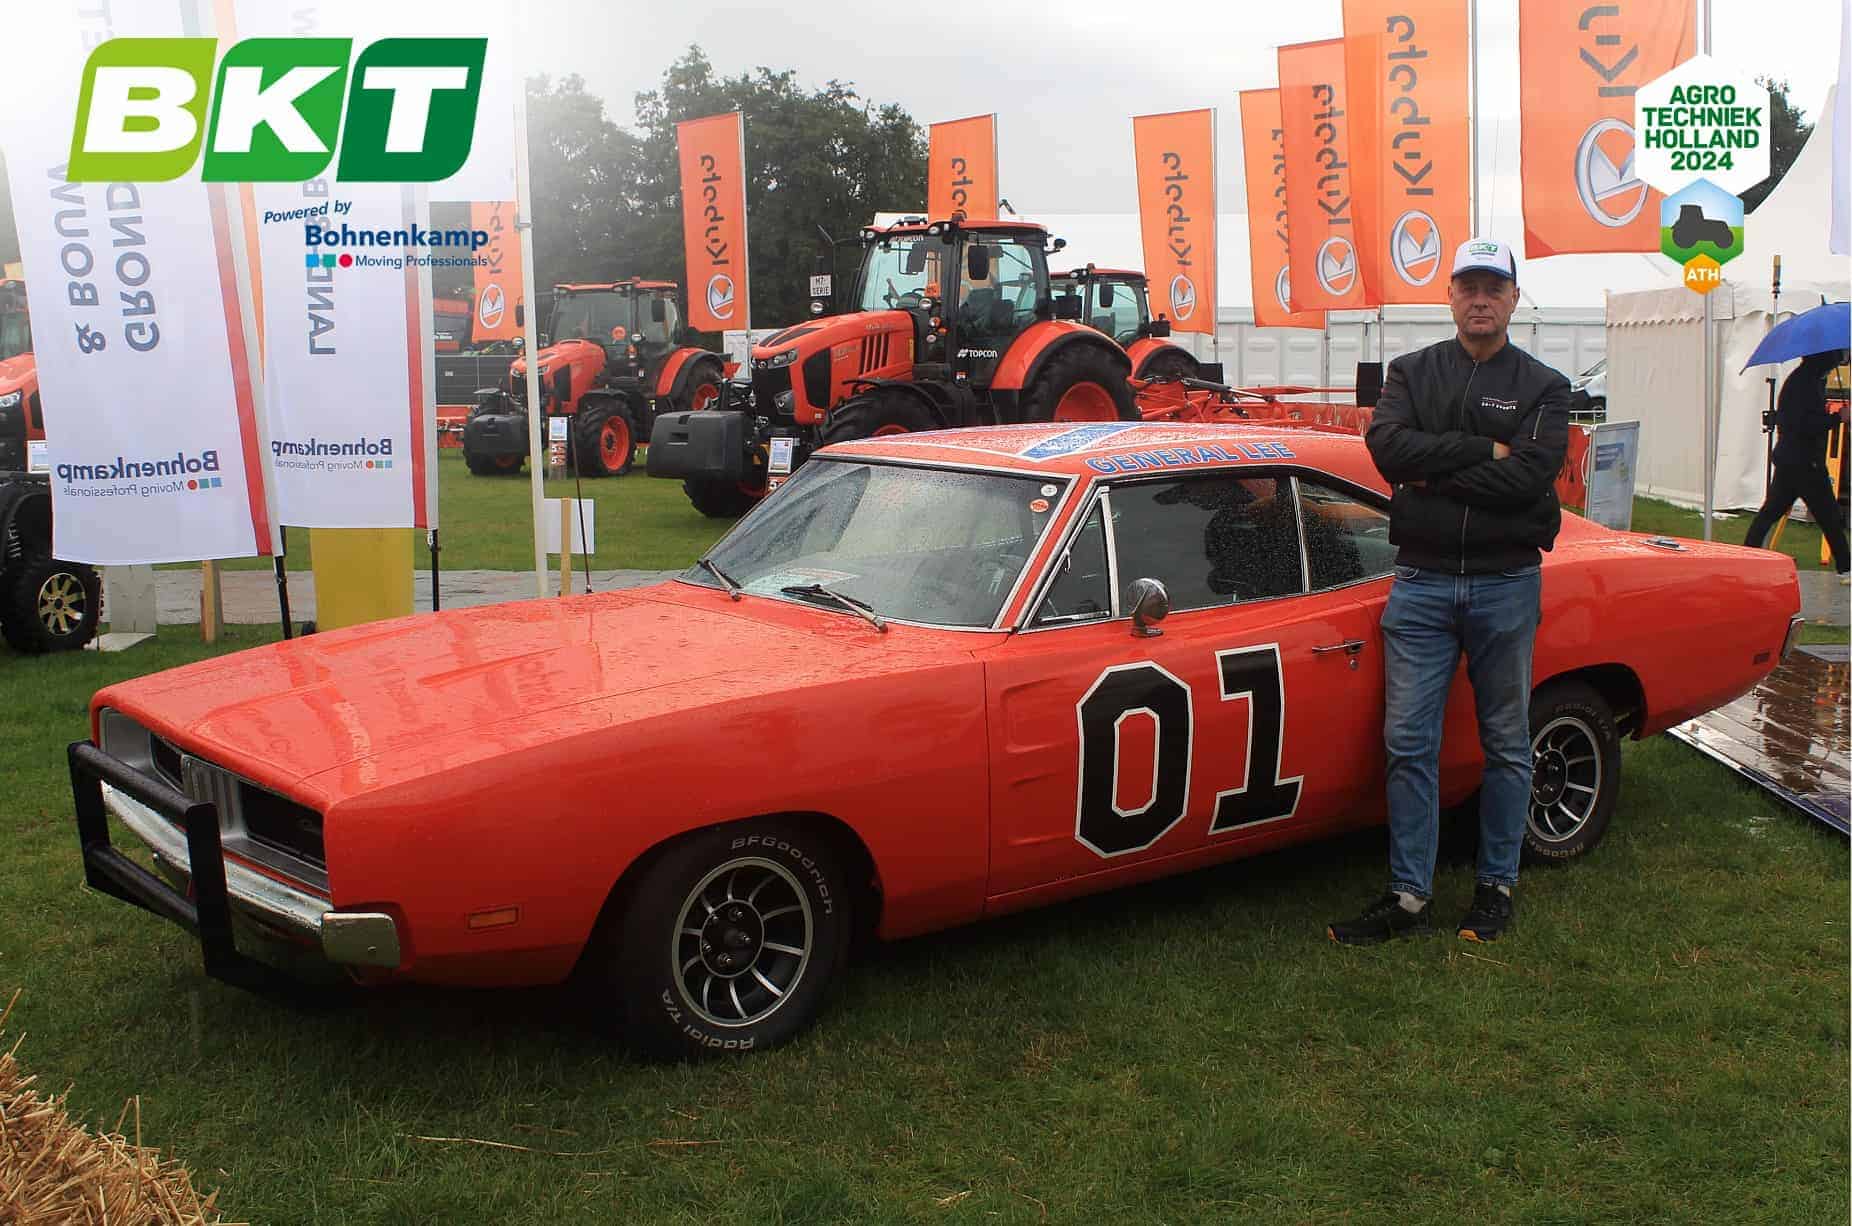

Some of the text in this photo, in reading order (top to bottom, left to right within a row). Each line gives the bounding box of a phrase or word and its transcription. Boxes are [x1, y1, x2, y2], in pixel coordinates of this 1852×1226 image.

[968, 349, 998, 358] TOPCON
[1084, 441, 1297, 474] GENERAL LEE
[1074, 642, 1304, 859] 01
[731, 835, 833, 916] BFGoodrich
[683, 1024, 754, 1050] Radial
